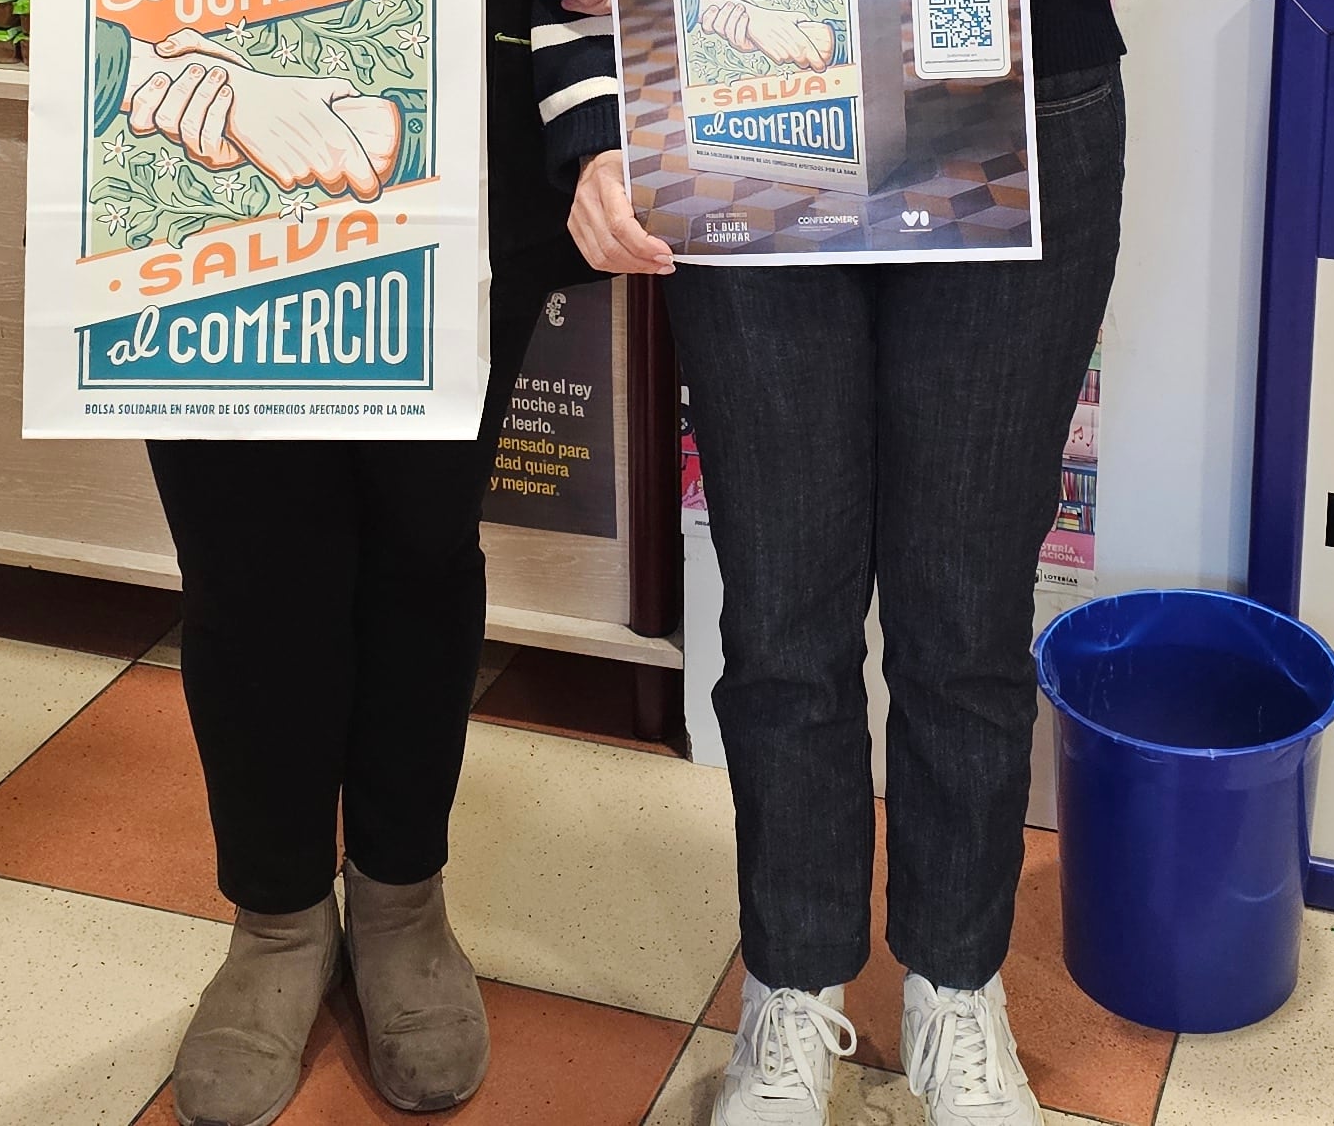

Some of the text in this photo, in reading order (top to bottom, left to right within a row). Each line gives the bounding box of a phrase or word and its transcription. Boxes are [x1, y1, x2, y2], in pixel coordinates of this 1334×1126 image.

[713, 80, 828, 107] SALVA
[702, 106, 846, 152] al COMERCIO
[706, 221, 748, 233] EL BUEN
[706, 232, 751, 243] COMPRAR
[138, 211, 380, 297] SALVA
[106, 269, 410, 367] al COMERCIO
[84, 403, 426, 416] BOLSA SOLIDARIA EN FAVOR DE LOS COMERCIOS AFECTADOS POR LA DANA
[511, 397, 585, 418] noche a la
[495, 454, 570, 479] dad quiera
[490, 476, 561, 496] y mejorar.
